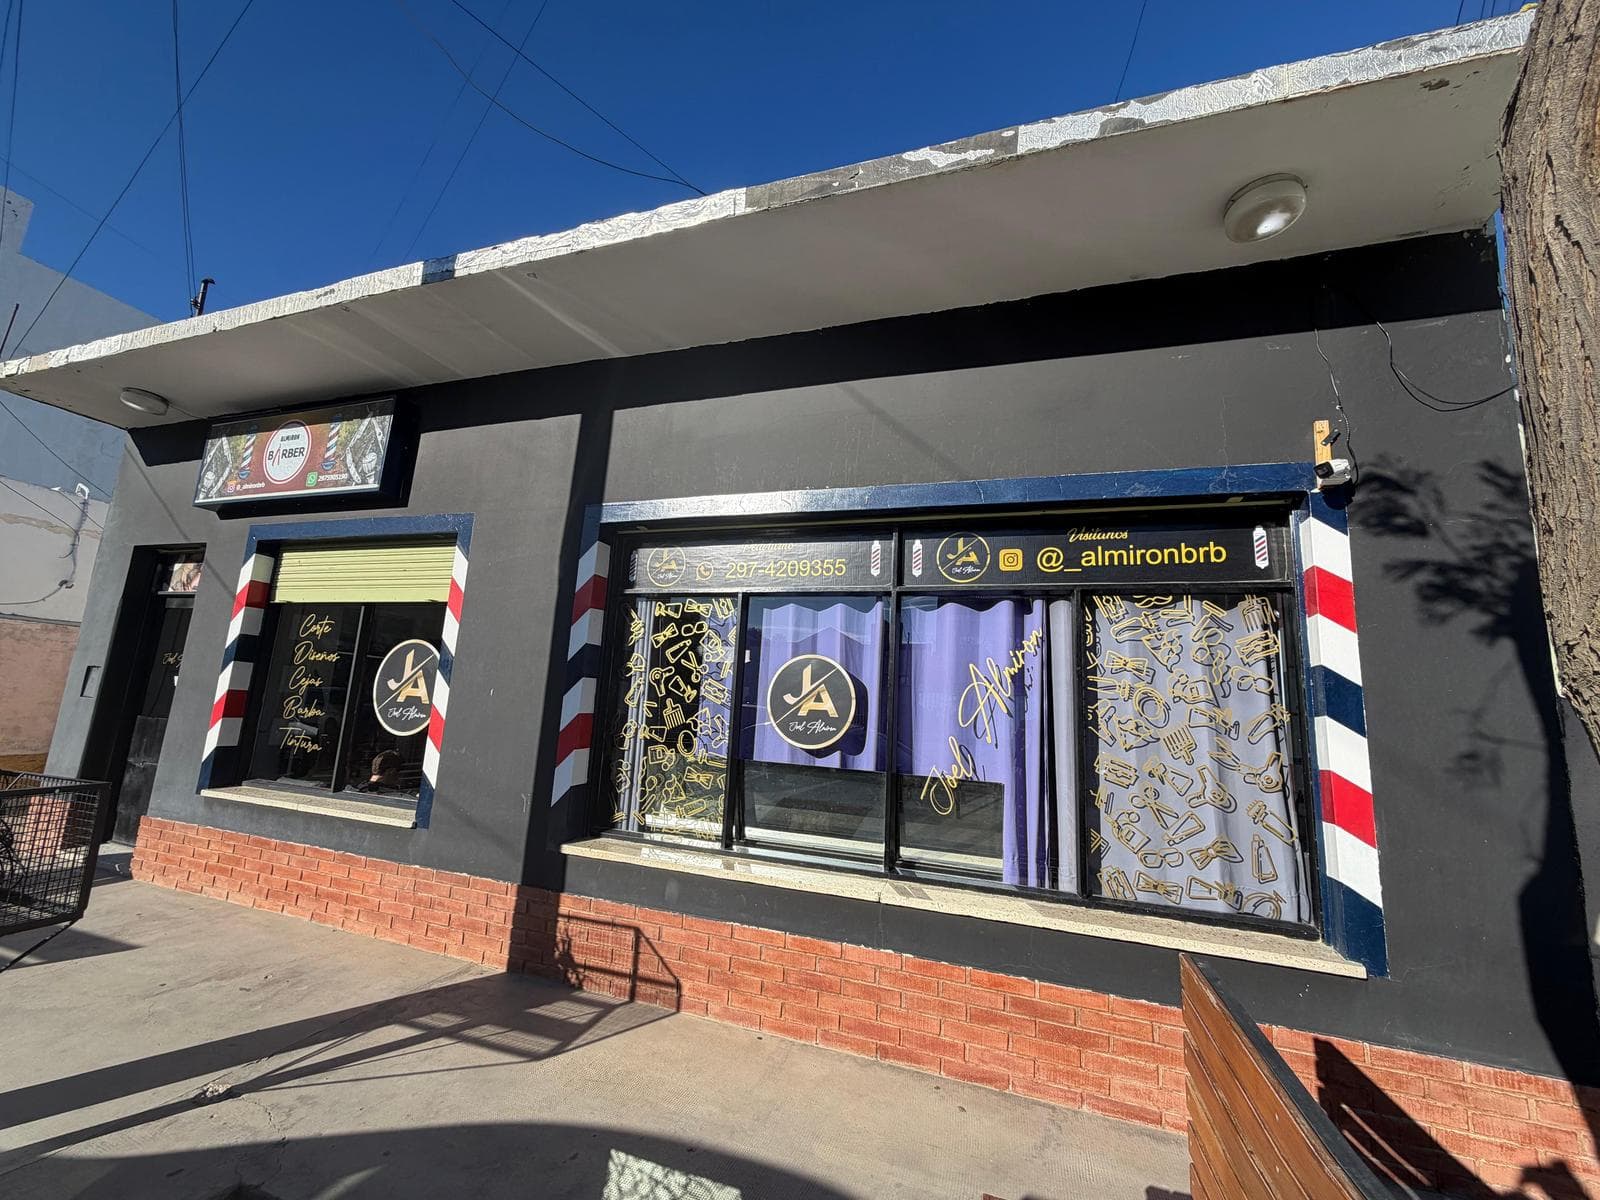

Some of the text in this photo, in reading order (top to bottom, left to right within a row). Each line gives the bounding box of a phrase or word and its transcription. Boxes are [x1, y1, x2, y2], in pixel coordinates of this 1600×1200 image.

[724, 558, 847, 579] 297-4209355
[1036, 541, 1227, 572] @_almironbrb
[299, 613, 336, 640] Corte
[293, 640, 341, 665] Diseños
[289, 665, 324, 696] Cejas
[282, 695, 326, 719] Barba
[279, 727, 323, 755] Tintura
[920, 736, 975, 816] Joel
